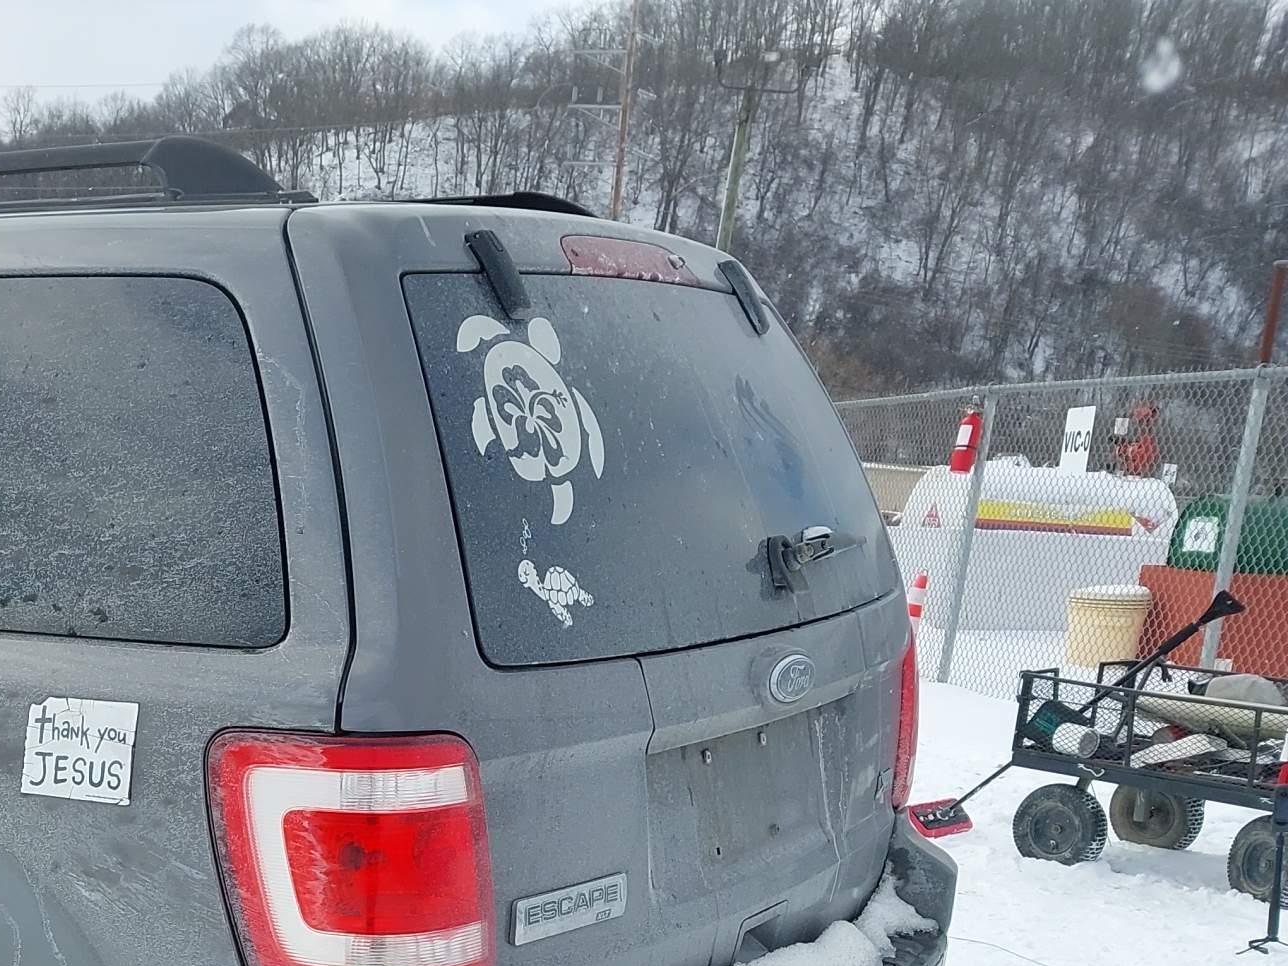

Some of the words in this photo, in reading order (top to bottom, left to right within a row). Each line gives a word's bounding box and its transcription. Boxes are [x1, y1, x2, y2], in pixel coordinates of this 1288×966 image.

[96, 726, 127, 754] you
[29, 751, 124, 791] JESUS
[526, 883, 619, 926] ESCAPE
